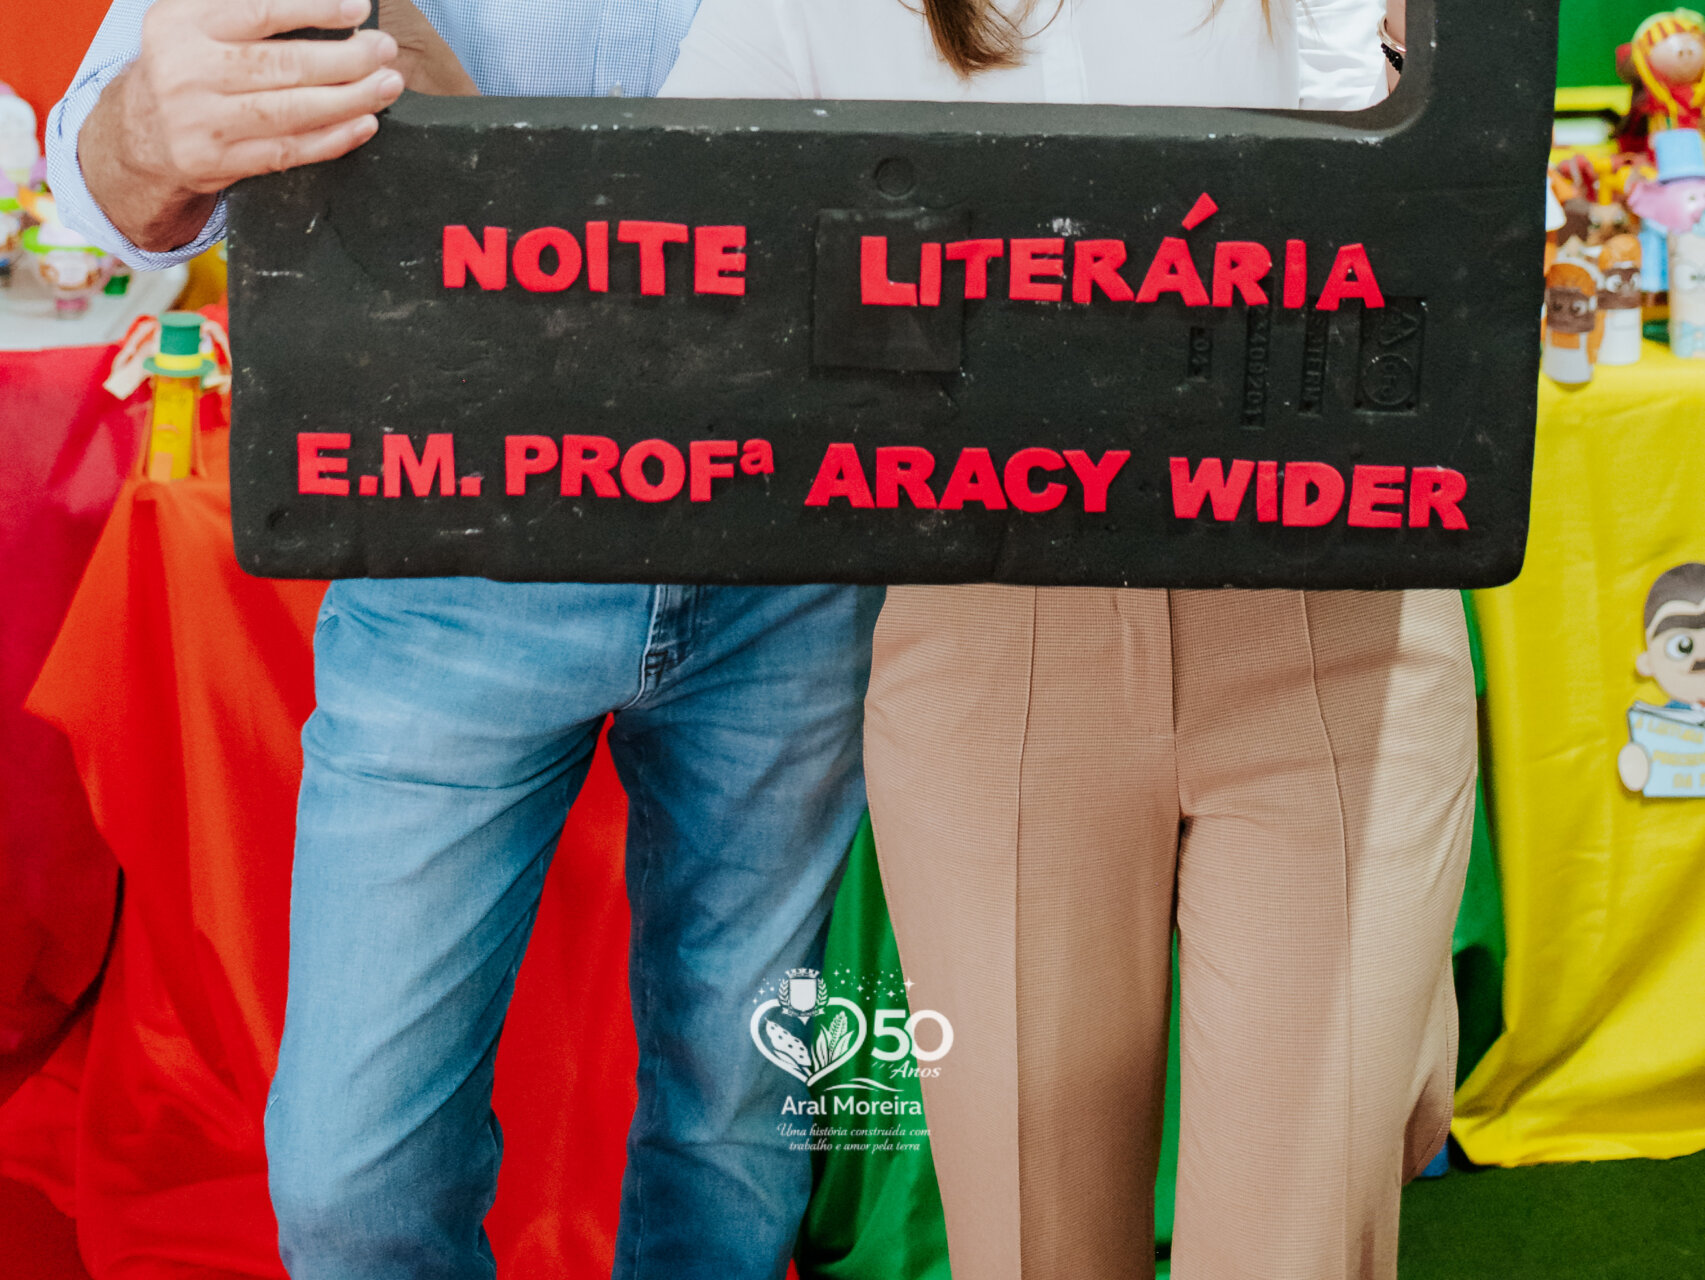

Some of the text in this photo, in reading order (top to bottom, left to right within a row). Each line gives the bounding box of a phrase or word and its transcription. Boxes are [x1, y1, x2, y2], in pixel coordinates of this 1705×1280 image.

[442, 192, 1385, 311] NOITE LITERÁRIA
[296, 432, 483, 498] E.M.
[804, 442, 1131, 513] ARACY
[1169, 456, 1469, 530] WIDER
